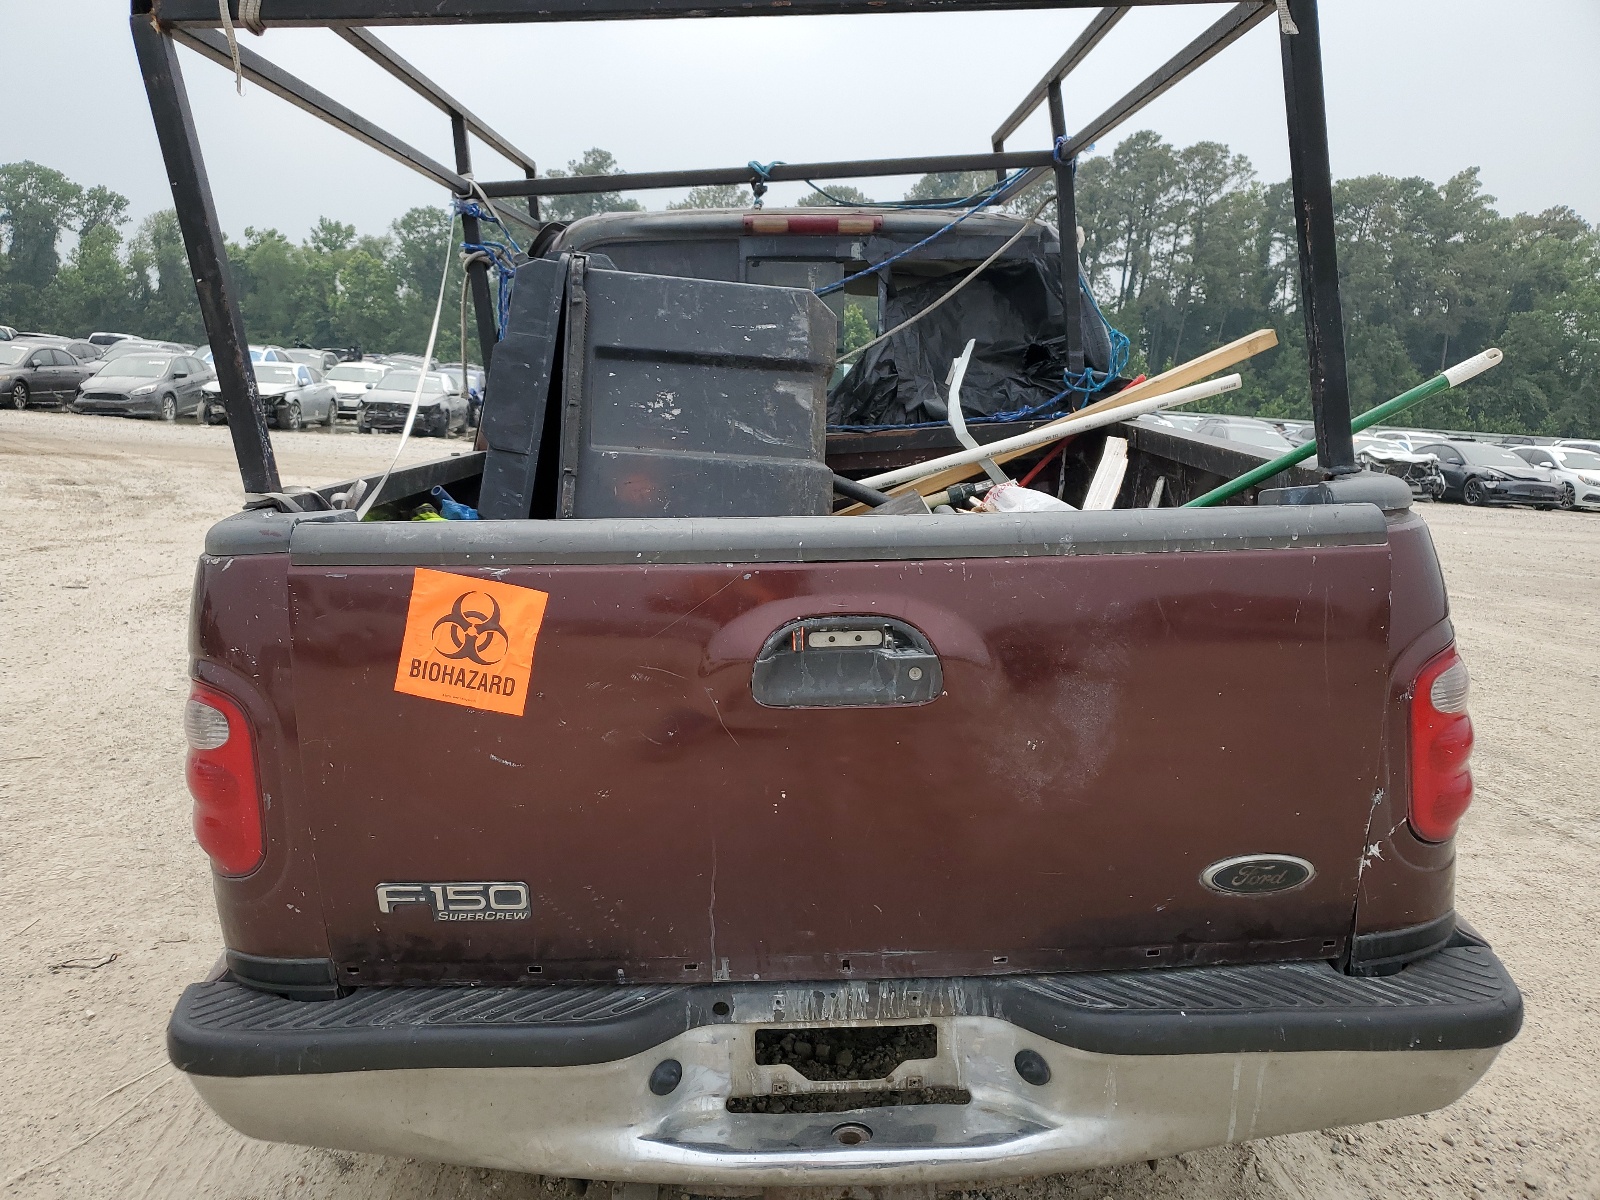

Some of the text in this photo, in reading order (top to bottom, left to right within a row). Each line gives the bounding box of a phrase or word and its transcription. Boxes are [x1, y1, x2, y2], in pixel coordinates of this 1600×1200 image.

[409, 658, 516, 697] BIOHAZARD
[1231, 865, 1288, 886] Ford
[377, 885, 528, 914] F-150
